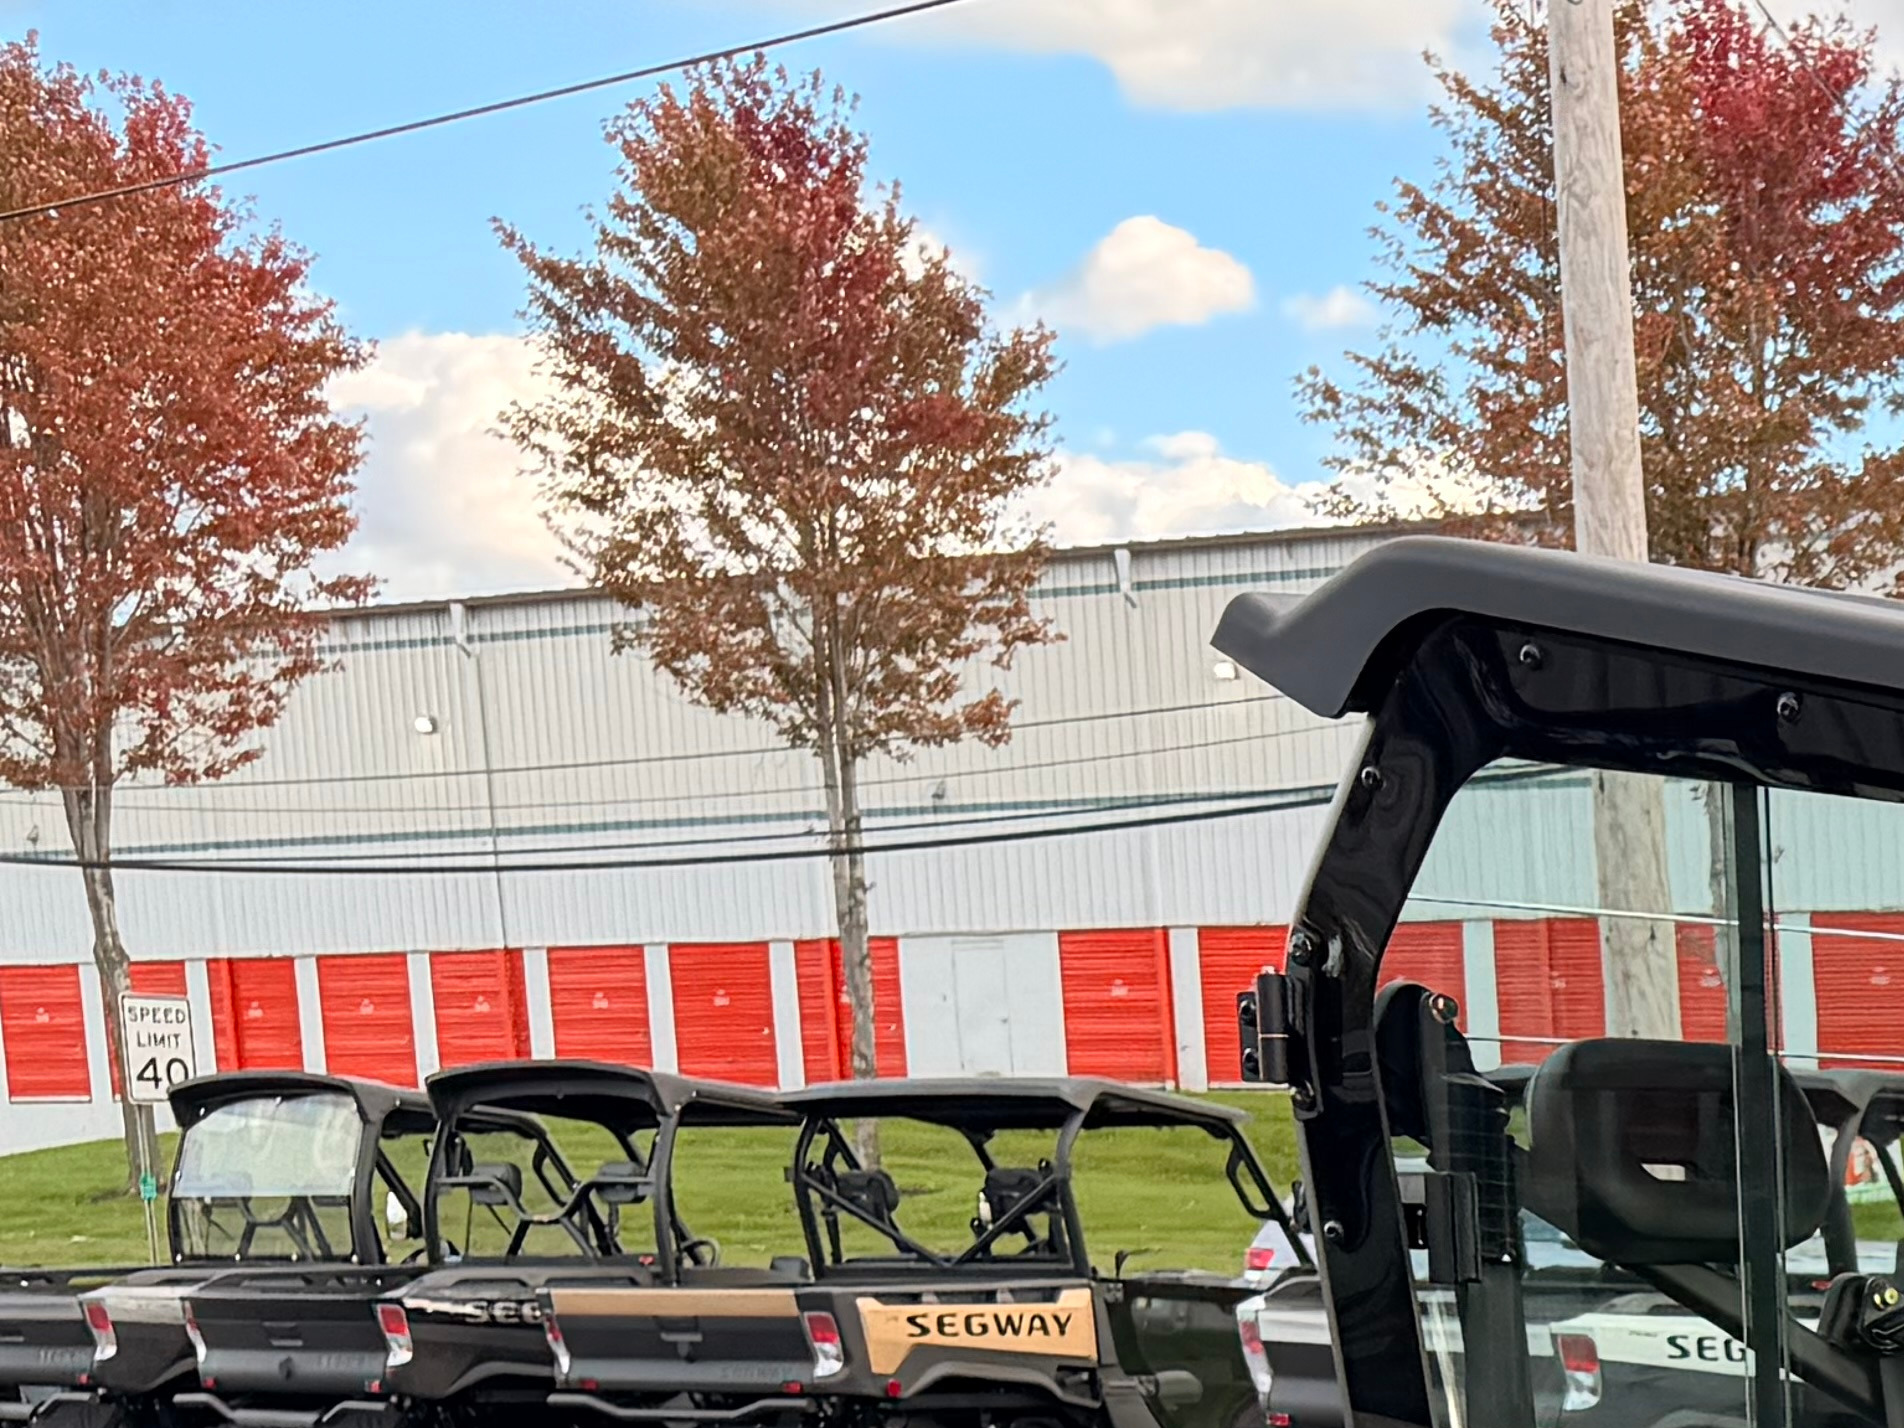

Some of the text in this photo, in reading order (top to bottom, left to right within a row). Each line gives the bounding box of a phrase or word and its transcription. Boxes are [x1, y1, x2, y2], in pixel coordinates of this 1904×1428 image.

[127, 1005, 186, 1024] SPEED
[136, 1031, 181, 1049] LIMIT
[136, 1057, 190, 1090] 40
[906, 1312, 1072, 1338] SEGWAY
